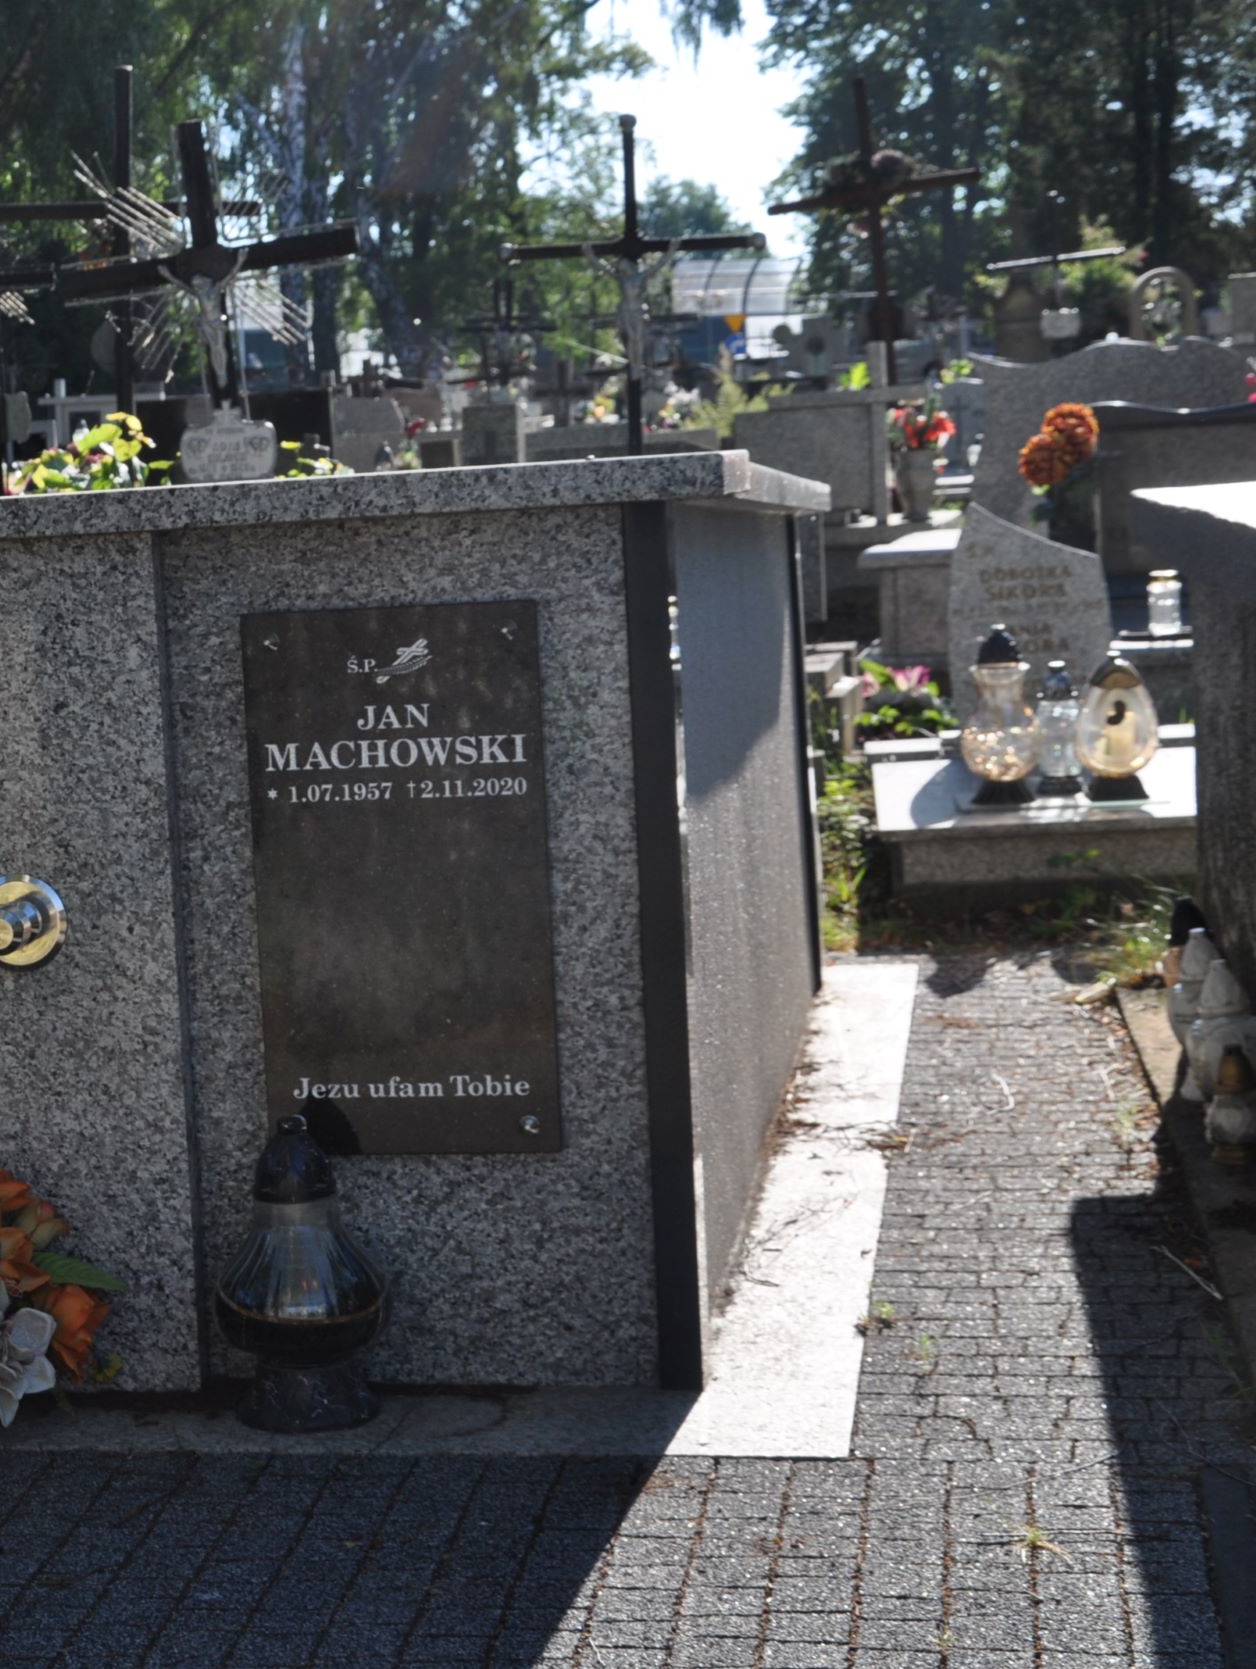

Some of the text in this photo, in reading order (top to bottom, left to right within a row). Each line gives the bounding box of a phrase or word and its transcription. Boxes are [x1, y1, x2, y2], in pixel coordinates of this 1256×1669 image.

[357, 703, 430, 730] JAN
[264, 734, 528, 773] MACHOWSKI
[293, 1074, 530, 1100] Jezu ufam Tobie
